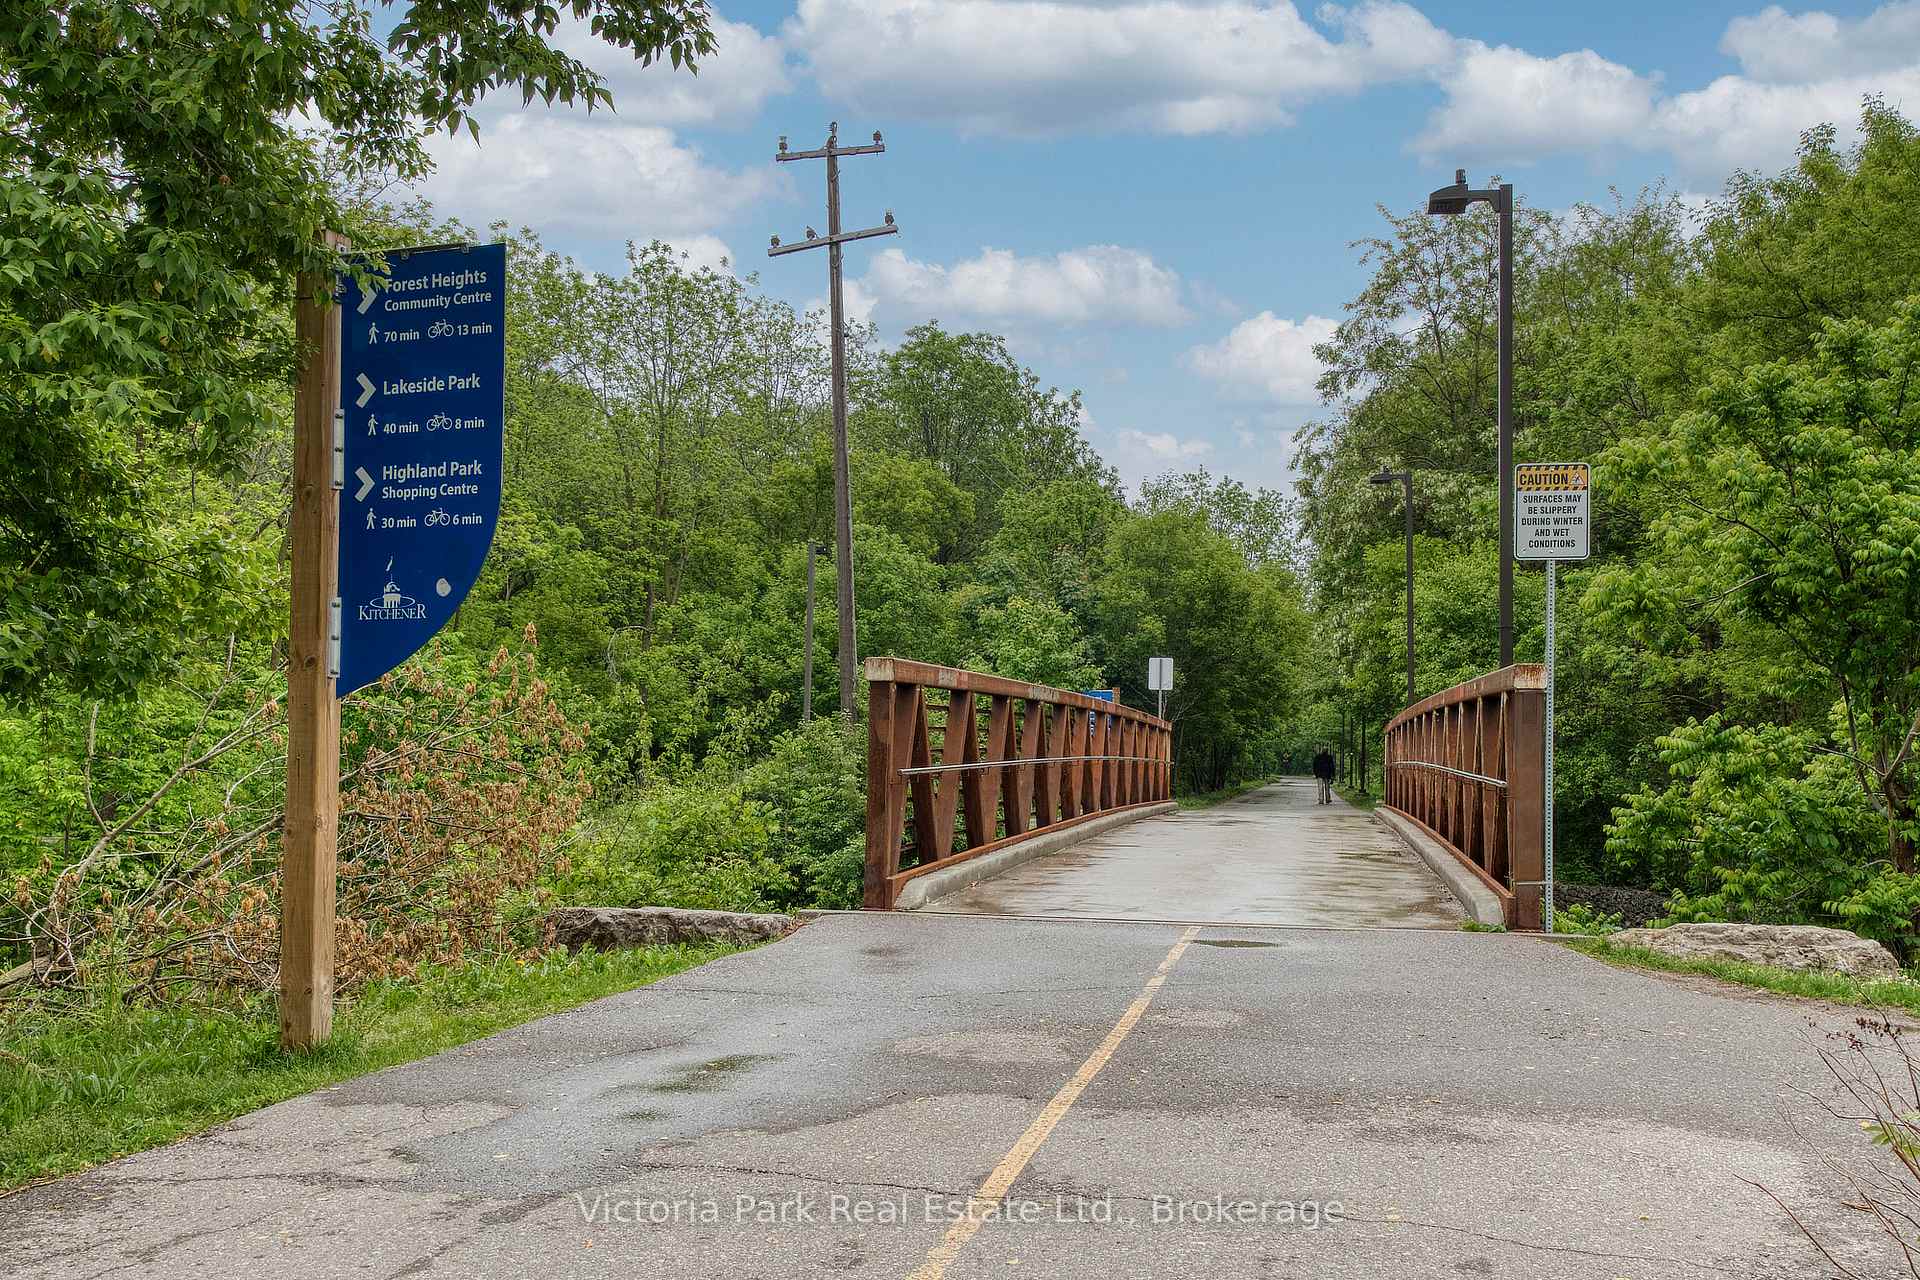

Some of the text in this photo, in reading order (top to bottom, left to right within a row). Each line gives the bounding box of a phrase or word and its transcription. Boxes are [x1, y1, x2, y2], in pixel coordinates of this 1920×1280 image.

[431, 270, 487, 290] Heights
[384, 291, 492, 312] Community Centre
[384, 323, 493, 343] 70 min 13 min
[383, 373, 481, 396] Lakeside Park
[383, 417, 485, 434] 40 min 8 min
[382, 460, 482, 483] Highland Park
[1520, 473, 1569, 486] CAUTION
[382, 484, 478, 501] Shopping Centre
[1523, 494, 1582, 503] SURFACES MAY
[1528, 506, 1577, 515] BE SLIPPERY
[381, 513, 482, 529] 30 min 6 min
[1521, 517, 1583, 526] DURING WINTER
[1534, 528, 1570, 537] AND WET
[1528, 539, 1576, 548] CONDITIONS
